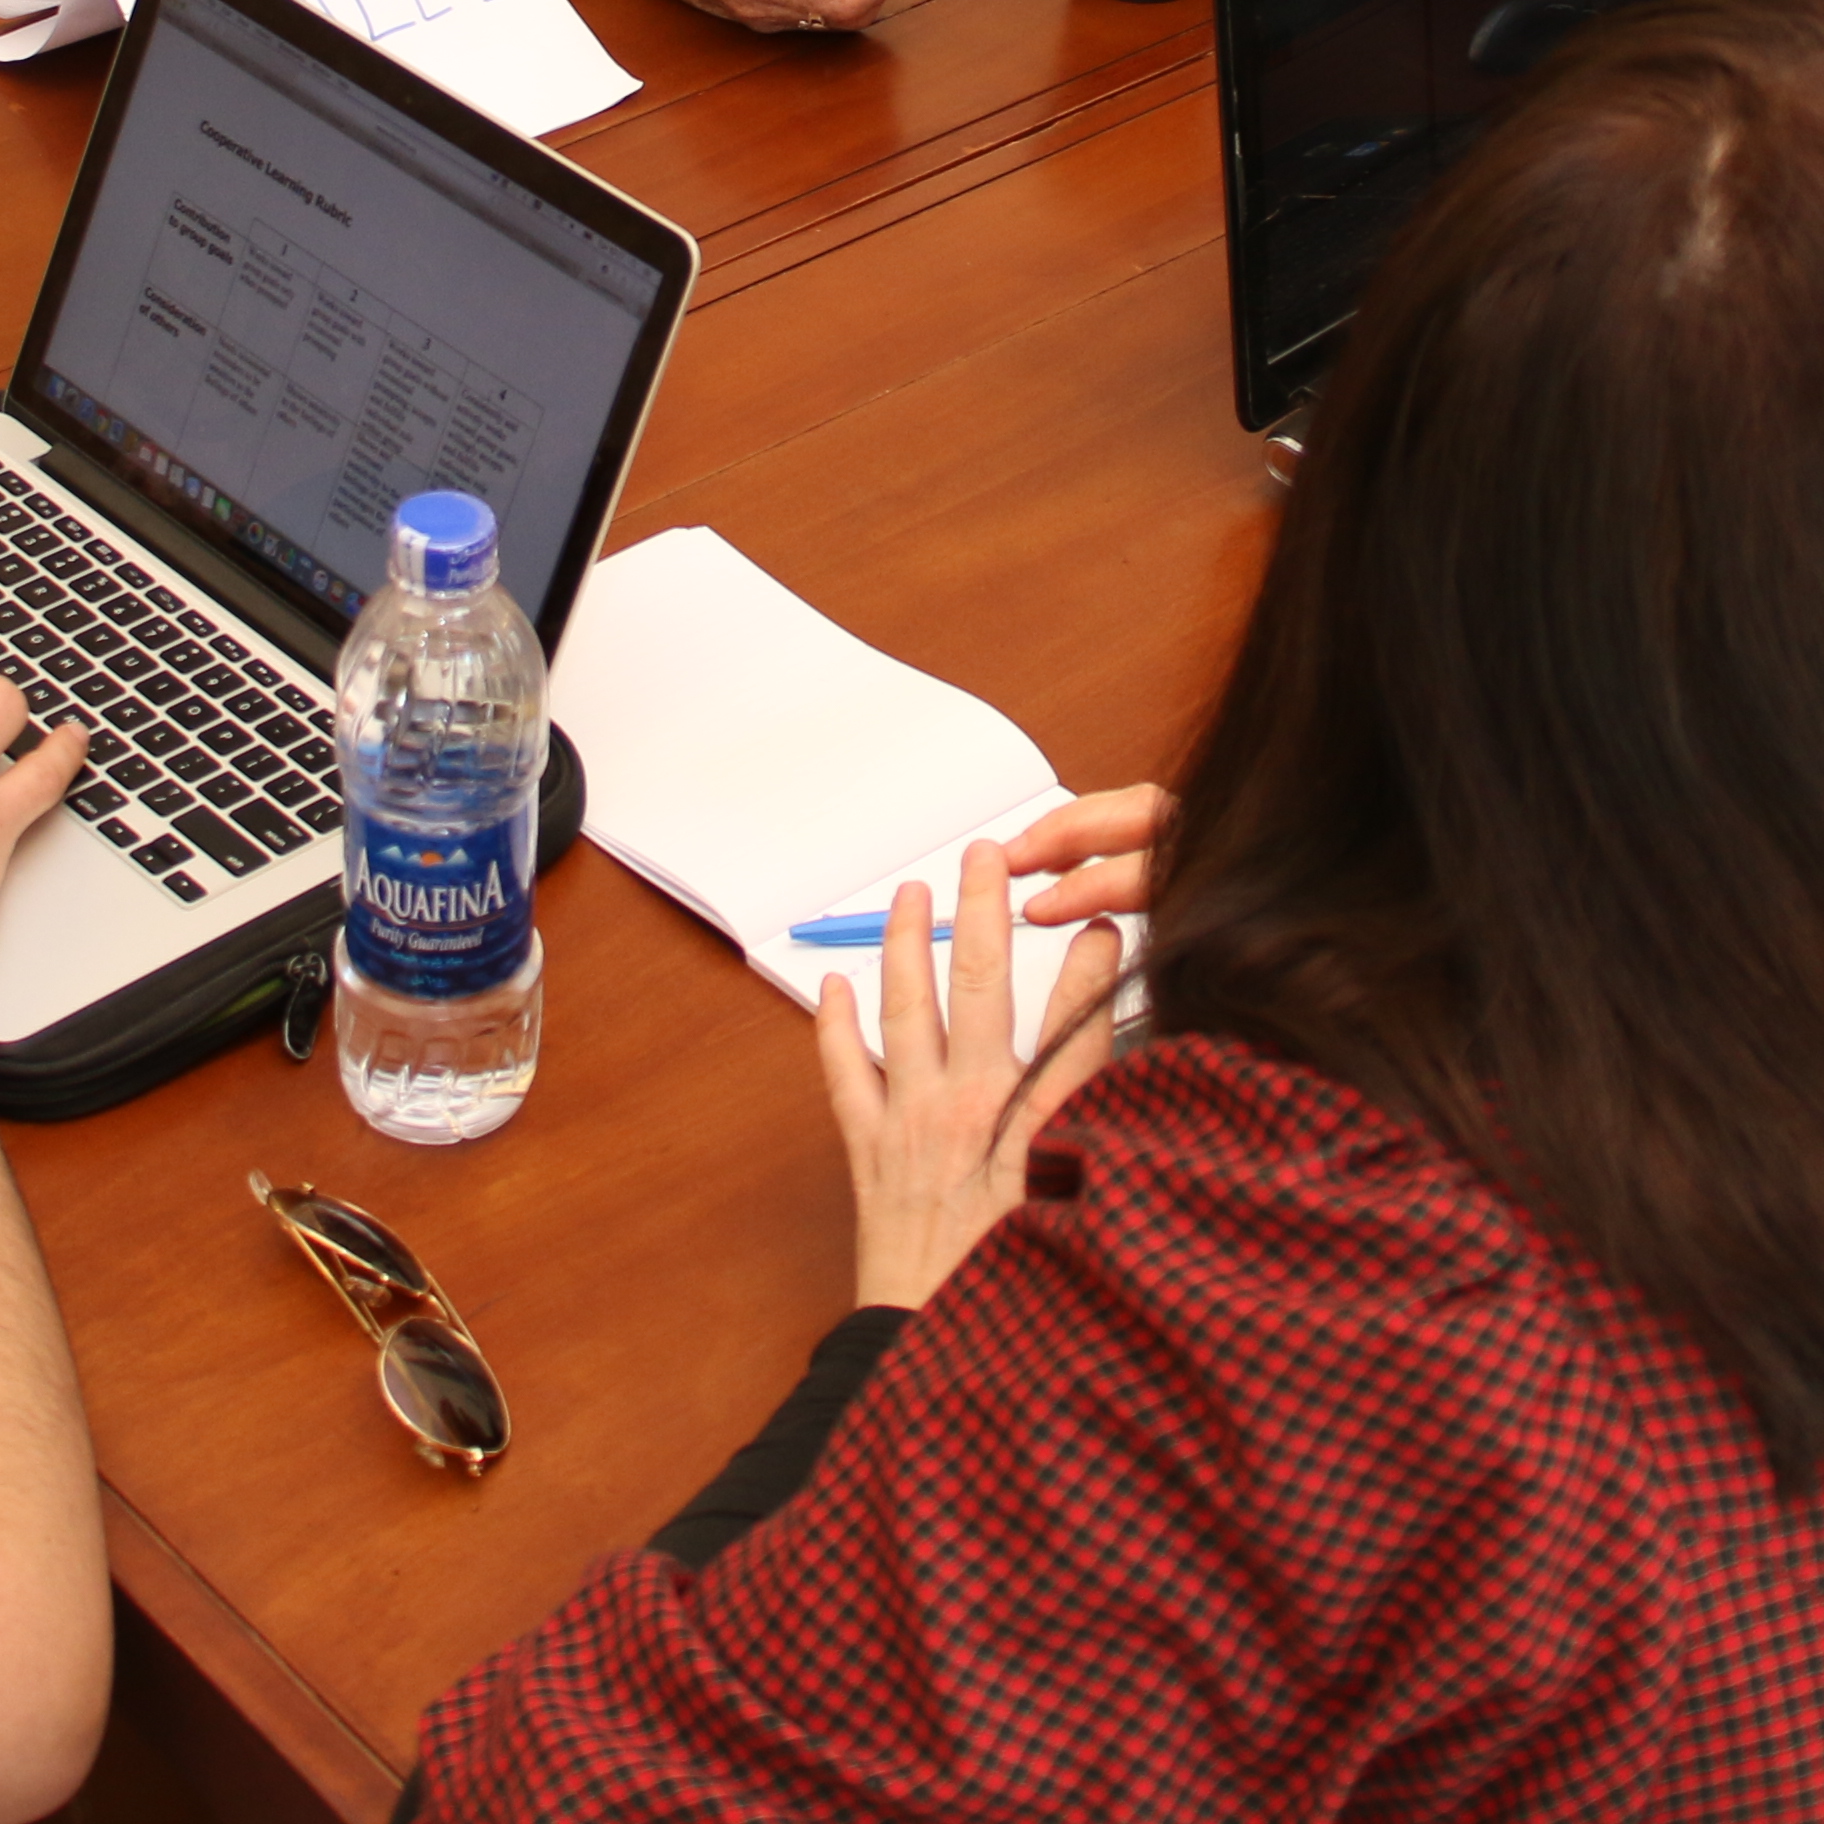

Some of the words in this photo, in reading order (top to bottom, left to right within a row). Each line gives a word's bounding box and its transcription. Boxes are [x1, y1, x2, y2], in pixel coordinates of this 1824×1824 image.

[198, 119, 264, 172] Cooperative
[264, 161, 314, 205] Learning
[315, 194, 352, 228] Rubric
[167, 214, 179, 230] to
[179, 221, 208, 249] group
[208, 240, 234, 267] goals
[173, 197, 231, 243] Contribution
[139, 301, 150, 316] of
[149, 309, 180, 338] others
[143, 285, 207, 336] Consideration
[30, 634, 46, 645] G
[59, 657, 75, 669] H
[121, 707, 138, 718] K
[34, 586, 48, 596] R
[95, 633, 110, 643] Y
[124, 657, 140, 668] U
[218, 730, 234, 740] P
[33, 689, 50, 701] N
[356, 847, 507, 925] AQUAFINA
[371, 918, 406, 950] Purity
[407, 926, 485, 952] Guaranteed
